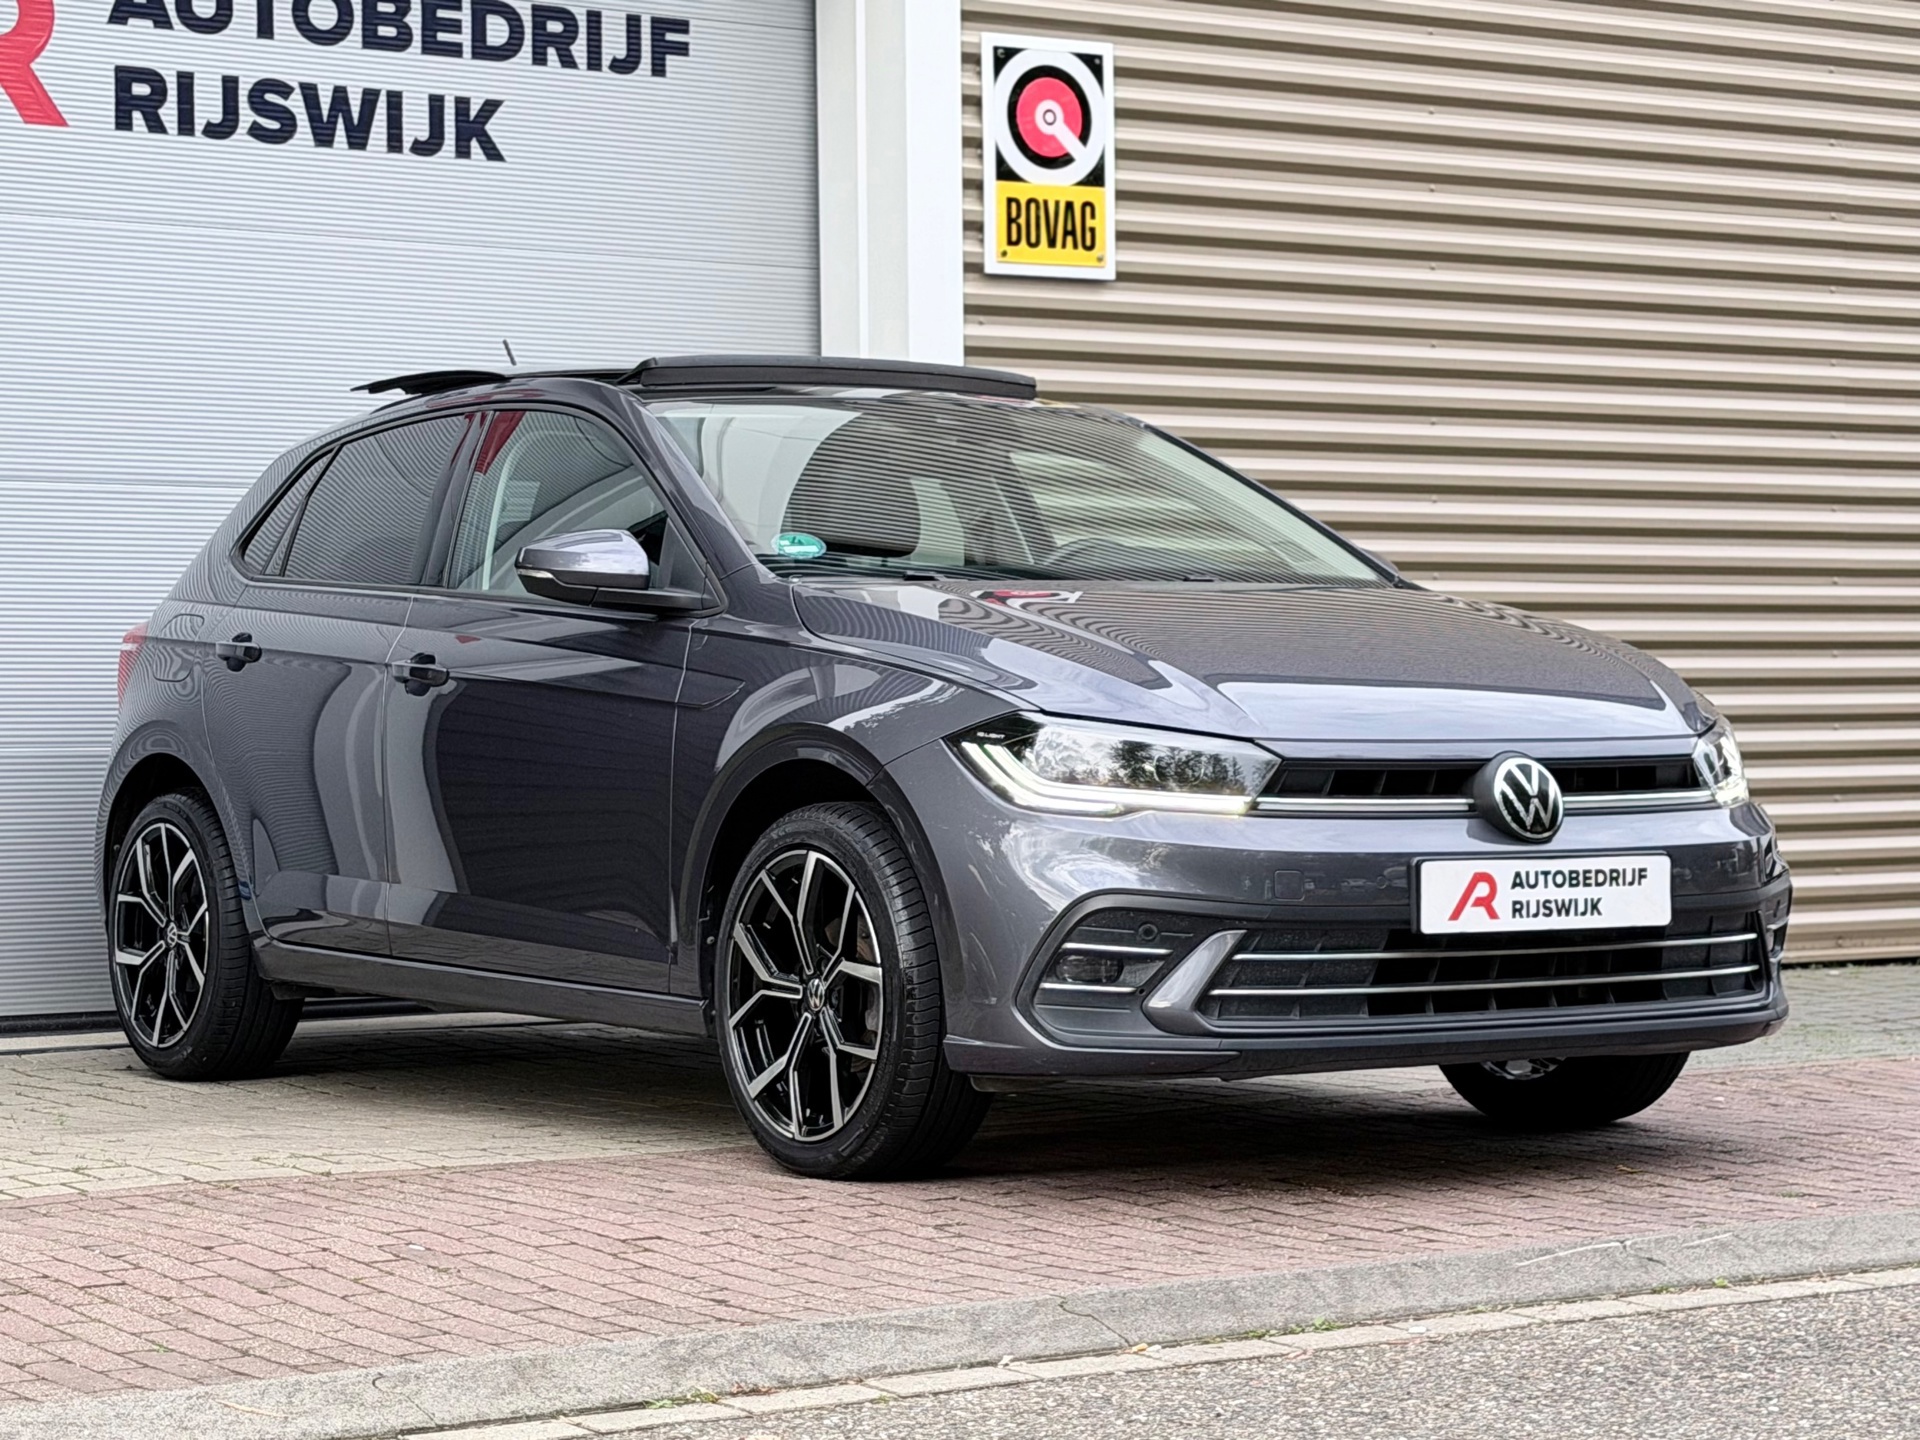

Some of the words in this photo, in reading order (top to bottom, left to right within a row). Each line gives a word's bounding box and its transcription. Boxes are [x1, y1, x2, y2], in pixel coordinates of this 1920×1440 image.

[114, 65, 506, 162] RIJSWIJK
[1006, 197, 1096, 252] BOVAG
[1510, 867, 1648, 890] AUTOBEDRIJF
[1510, 897, 1603, 919] RIJSWIJK
